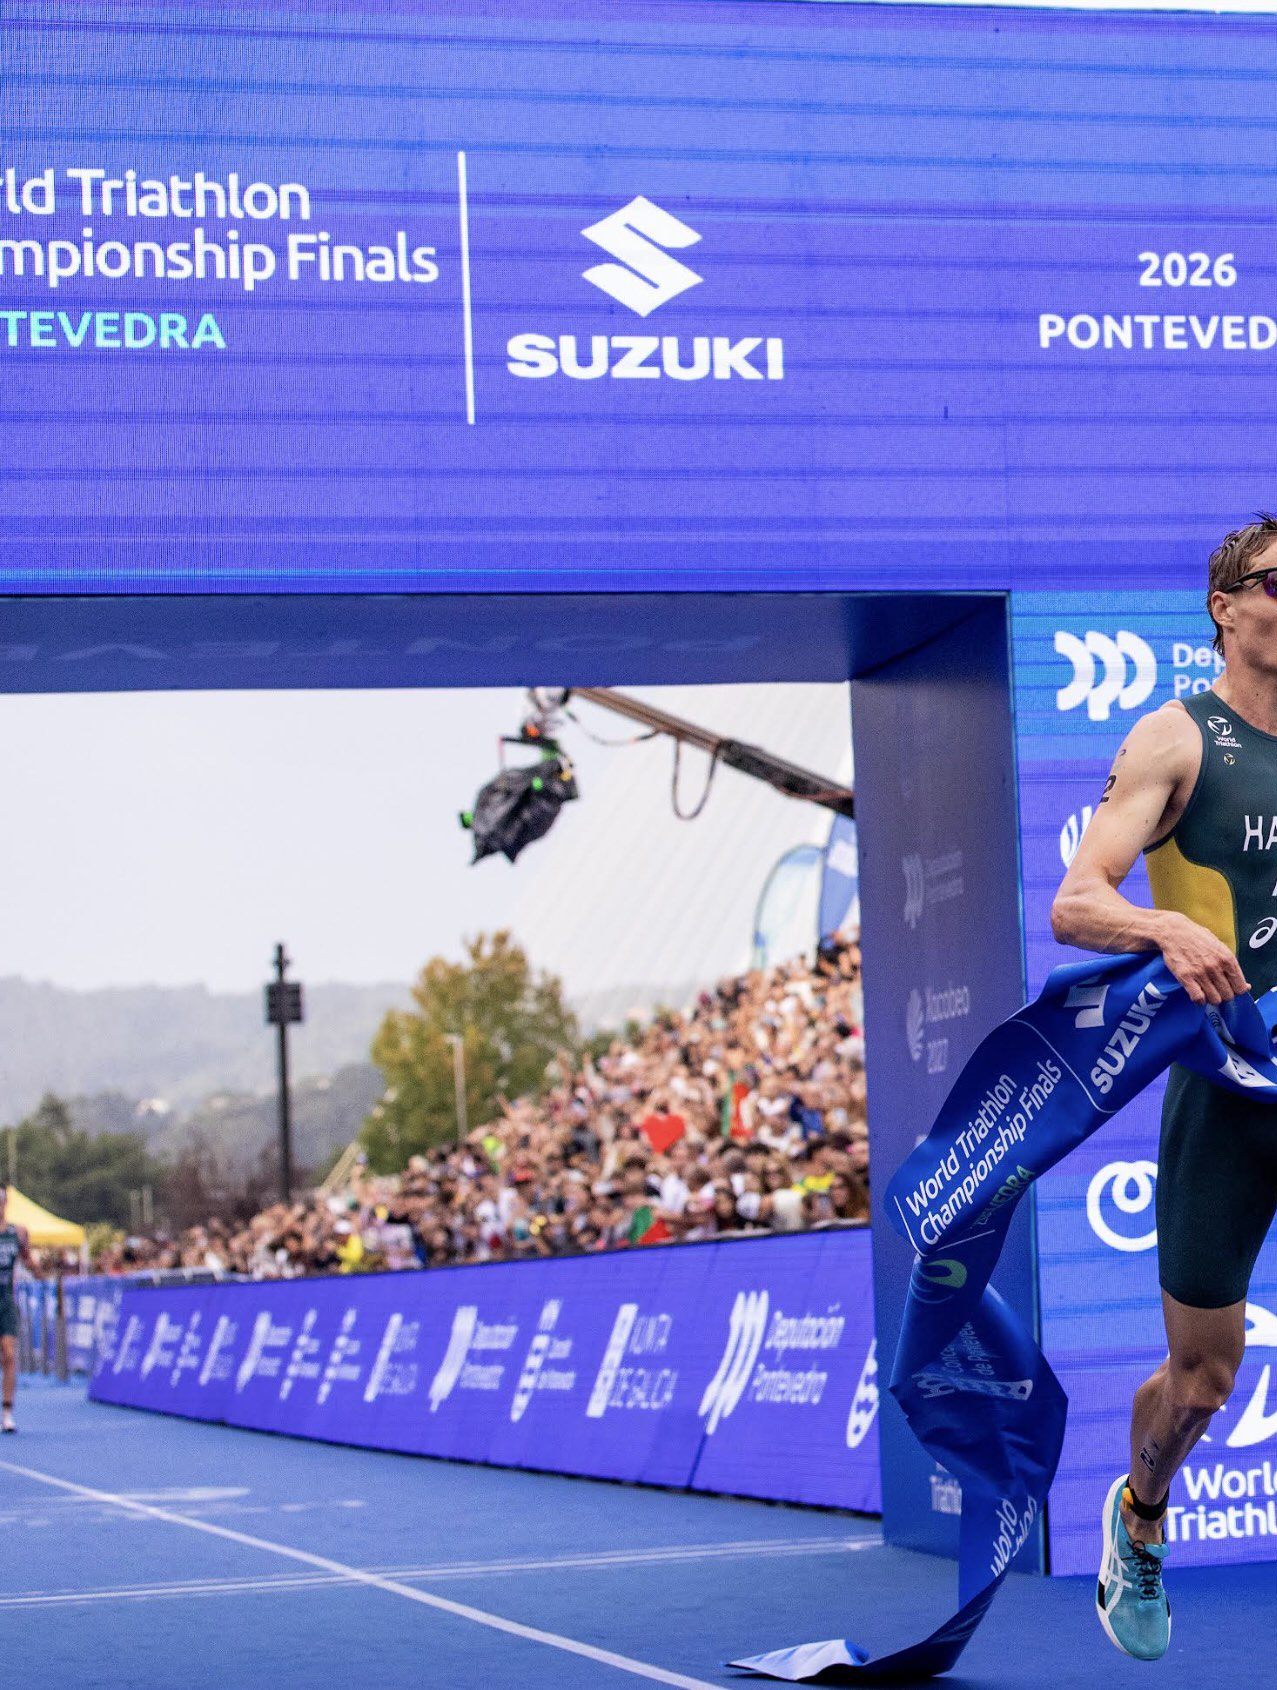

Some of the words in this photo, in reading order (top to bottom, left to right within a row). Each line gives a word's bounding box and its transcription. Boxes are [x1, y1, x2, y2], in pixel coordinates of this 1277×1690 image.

[66, 168, 311, 220] Triathlon
[0, 231, 276, 291] mpionship
[286, 230, 440, 284] Finals
[1138, 252, 1238, 288] 2026
[0, 310, 227, 350] TEVEDRA
[506, 333, 786, 381] SUZUKI
[1090, 981, 1170, 1094] SUZUKI
[905, 1146, 960, 1218] World
[955, 1073, 1018, 1159] Triathlon
[919, 1109, 1029, 1246] Championship
[1018, 1056, 1063, 1125] Finals
